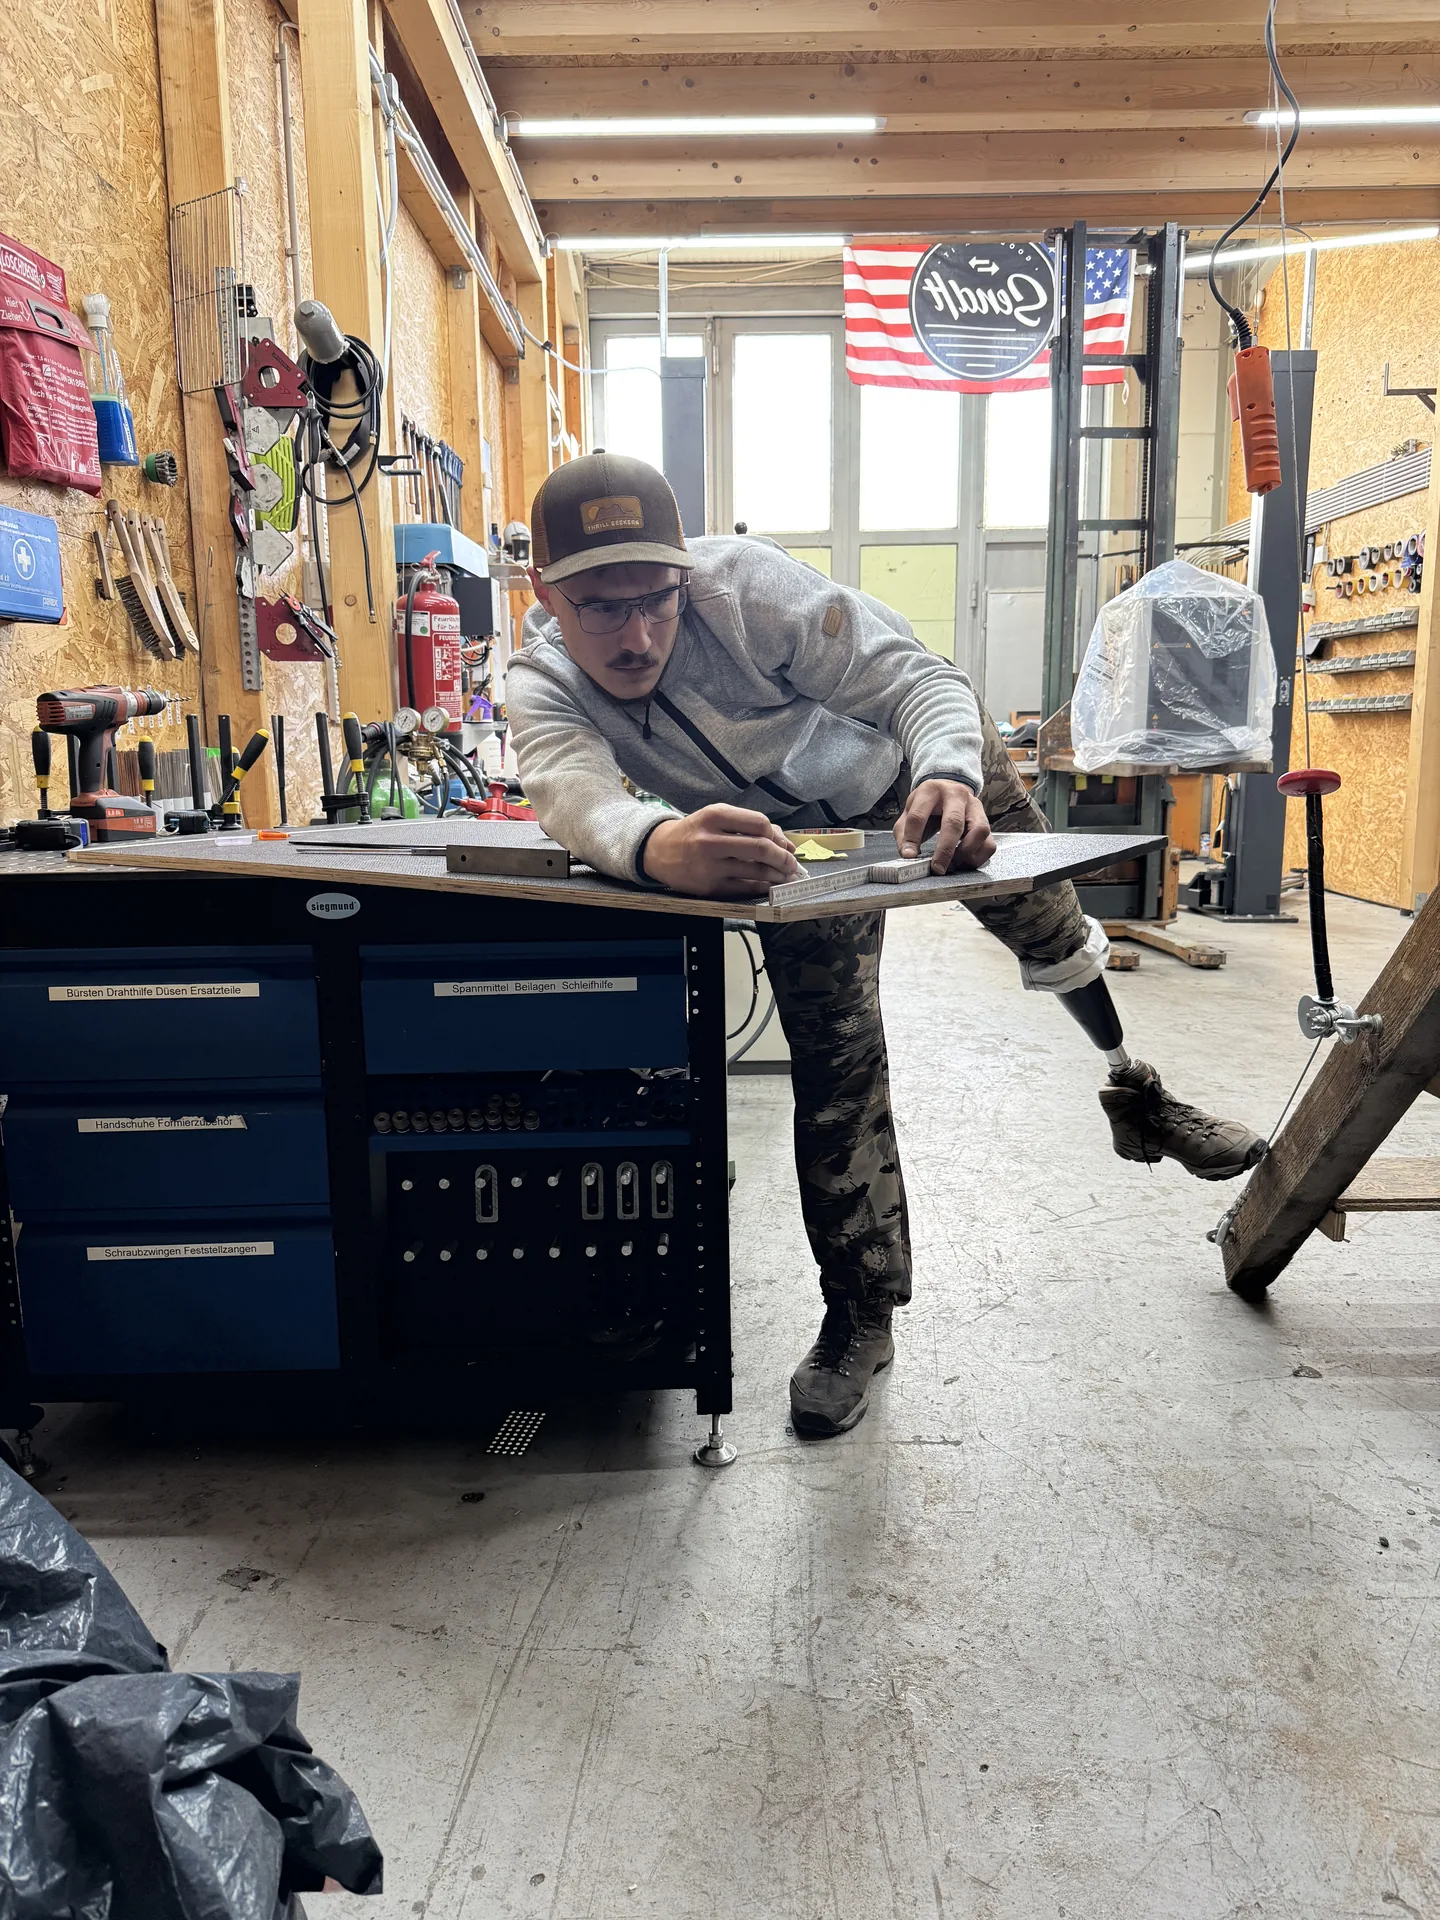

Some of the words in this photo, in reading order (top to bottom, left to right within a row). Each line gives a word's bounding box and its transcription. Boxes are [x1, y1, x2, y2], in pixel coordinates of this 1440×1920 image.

[588, 522, 610, 531] THRILL
[610, 519, 640, 528] SEEKERS
[311, 901, 355, 912] siegmund
[66, 988, 104, 998] Bürsten
[107, 987, 153, 997] Drahthilfe
[156, 986, 188, 996] Düsen
[190, 985, 242, 995] Ersatzteile
[452, 983, 509, 994] Spannmittel
[514, 982, 556, 993] Beilagen
[562, 979, 614, 990] Schleifhilfe
[95, 1119, 155, 1129] Handschuhe
[104, 1248, 181, 1258] Schraubzwingen
[184, 1244, 257, 1255] Feststellzangen
